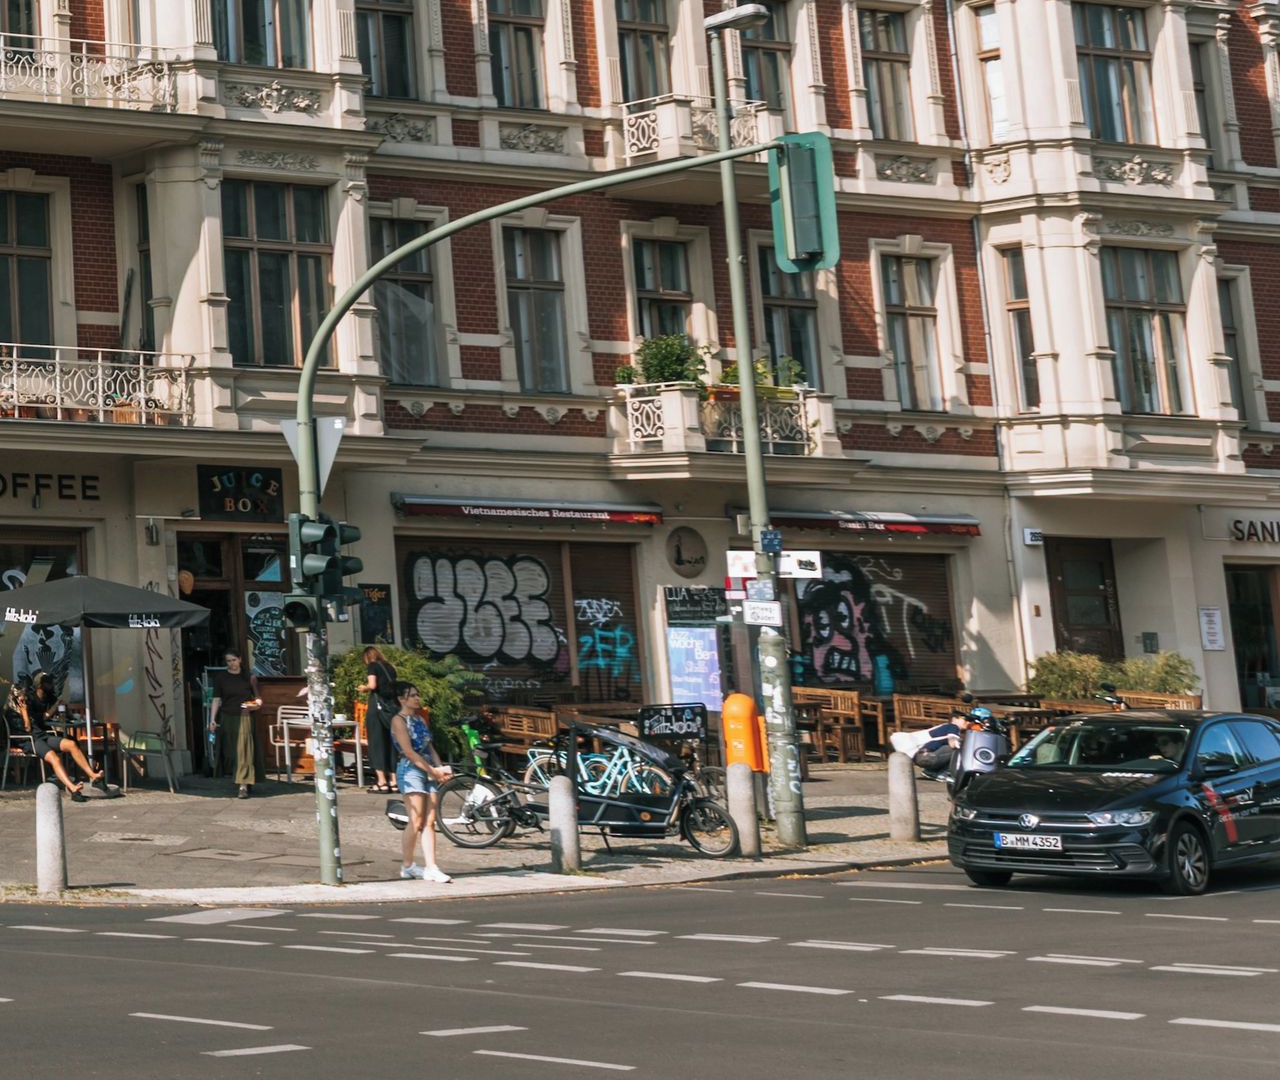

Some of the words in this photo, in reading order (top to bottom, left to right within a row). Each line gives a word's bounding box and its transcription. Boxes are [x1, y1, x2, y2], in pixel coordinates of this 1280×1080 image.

[210, 472, 280, 497] JUICE
[223, 498, 270, 513] BOX
[461, 506, 550, 518] Vietnamesisches
[552, 509, 610, 520] Restaurant
[868, 521, 886, 530] Bar
[364, 587, 386, 602] Tiger
[5, 607, 37, 624] fritz-kola
[1001, 835, 1009, 846] B
[1015, 836, 1030, 847] MM
[1032, 836, 1060, 848] 4352
